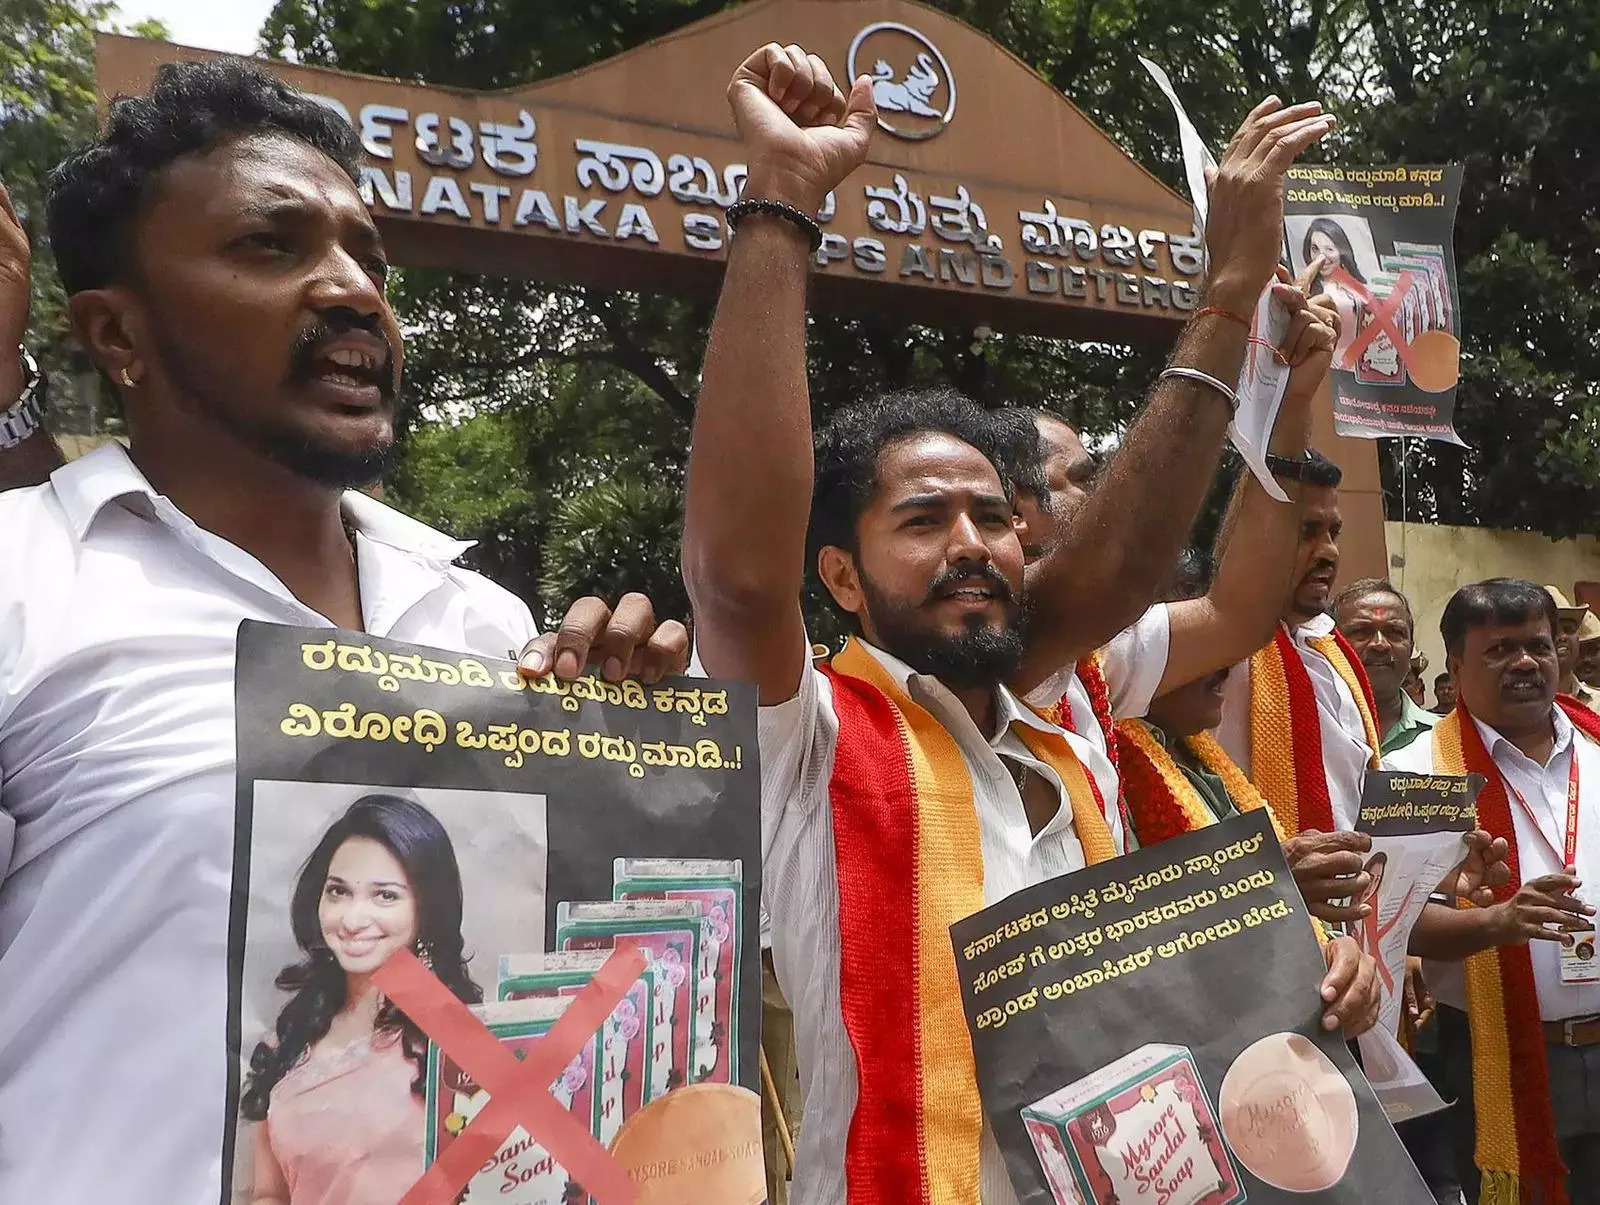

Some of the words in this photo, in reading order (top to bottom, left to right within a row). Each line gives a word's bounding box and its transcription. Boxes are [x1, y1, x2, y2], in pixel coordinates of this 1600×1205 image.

[357, 165, 660, 244] NATAKA
[683, 213, 886, 273] SPS
[900, 244, 1012, 288] AND
[1027, 260, 1199, 311] DETERG
[301, 640, 494, 692] ರದ್ದುಮಾಡಿ
[653, 687, 729, 726] ಕನ್ನಡ
[280, 702, 447, 752] ವಿರೋಧಿ
[456, 720, 571, 767] ಒಪ್ಪಂದ
[963, 909, 1049, 961] ಕರ್ನಾಟಕದ
[1101, 863, 1184, 903] ಮೈಸೂರು
[1185, 832, 1264, 876] ಸ್ಯಾಂಡಲ್
[973, 955, 1026, 995] ಸೋಪ್
[1030, 947, 1047, 967] ಗೆ
[1048, 930, 1103, 961] ಉತ್ತರ
[1104, 889, 1218, 942] ಭಾರತದವರು
[1219, 869, 1275, 900] ಬಂದು
[976, 987, 1039, 1029] ಬ್ರಾಂಡ್
[1042, 945, 1155, 1001] ಅಂಬಾಸಿಡರ್
[1157, 917, 1241, 958] ಆಗೋದು
[627, 1159, 678, 1182] YSORE
[1120, 1104, 1175, 1180] Mysore
[1134, 1116, 1187, 1194] Sandal
[1155, 1157, 1194, 1205] Soap
